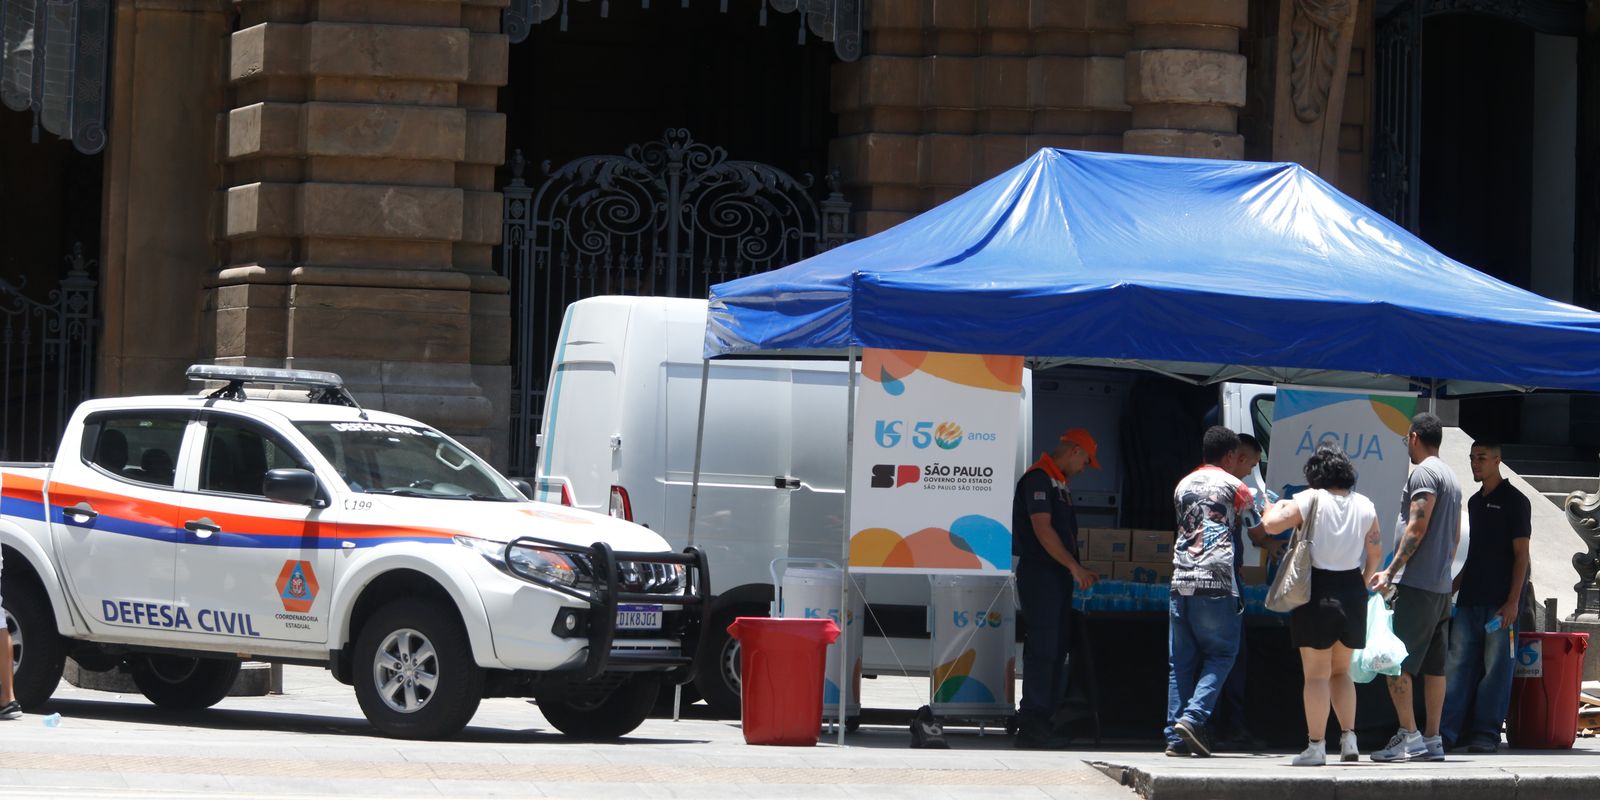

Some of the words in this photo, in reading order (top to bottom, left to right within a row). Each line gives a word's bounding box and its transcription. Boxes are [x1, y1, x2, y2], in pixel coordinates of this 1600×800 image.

[968, 431, 996, 441] anos
[924, 463, 950, 476] SÃO
[953, 466, 993, 477] PAULO
[352, 500, 373, 511] 199
[102, 600, 192, 629] DEFESA
[198, 609, 260, 636] CIVIL
[275, 614, 319, 622] COORDENADORIA
[285, 622, 312, 630] ESTADUAL
